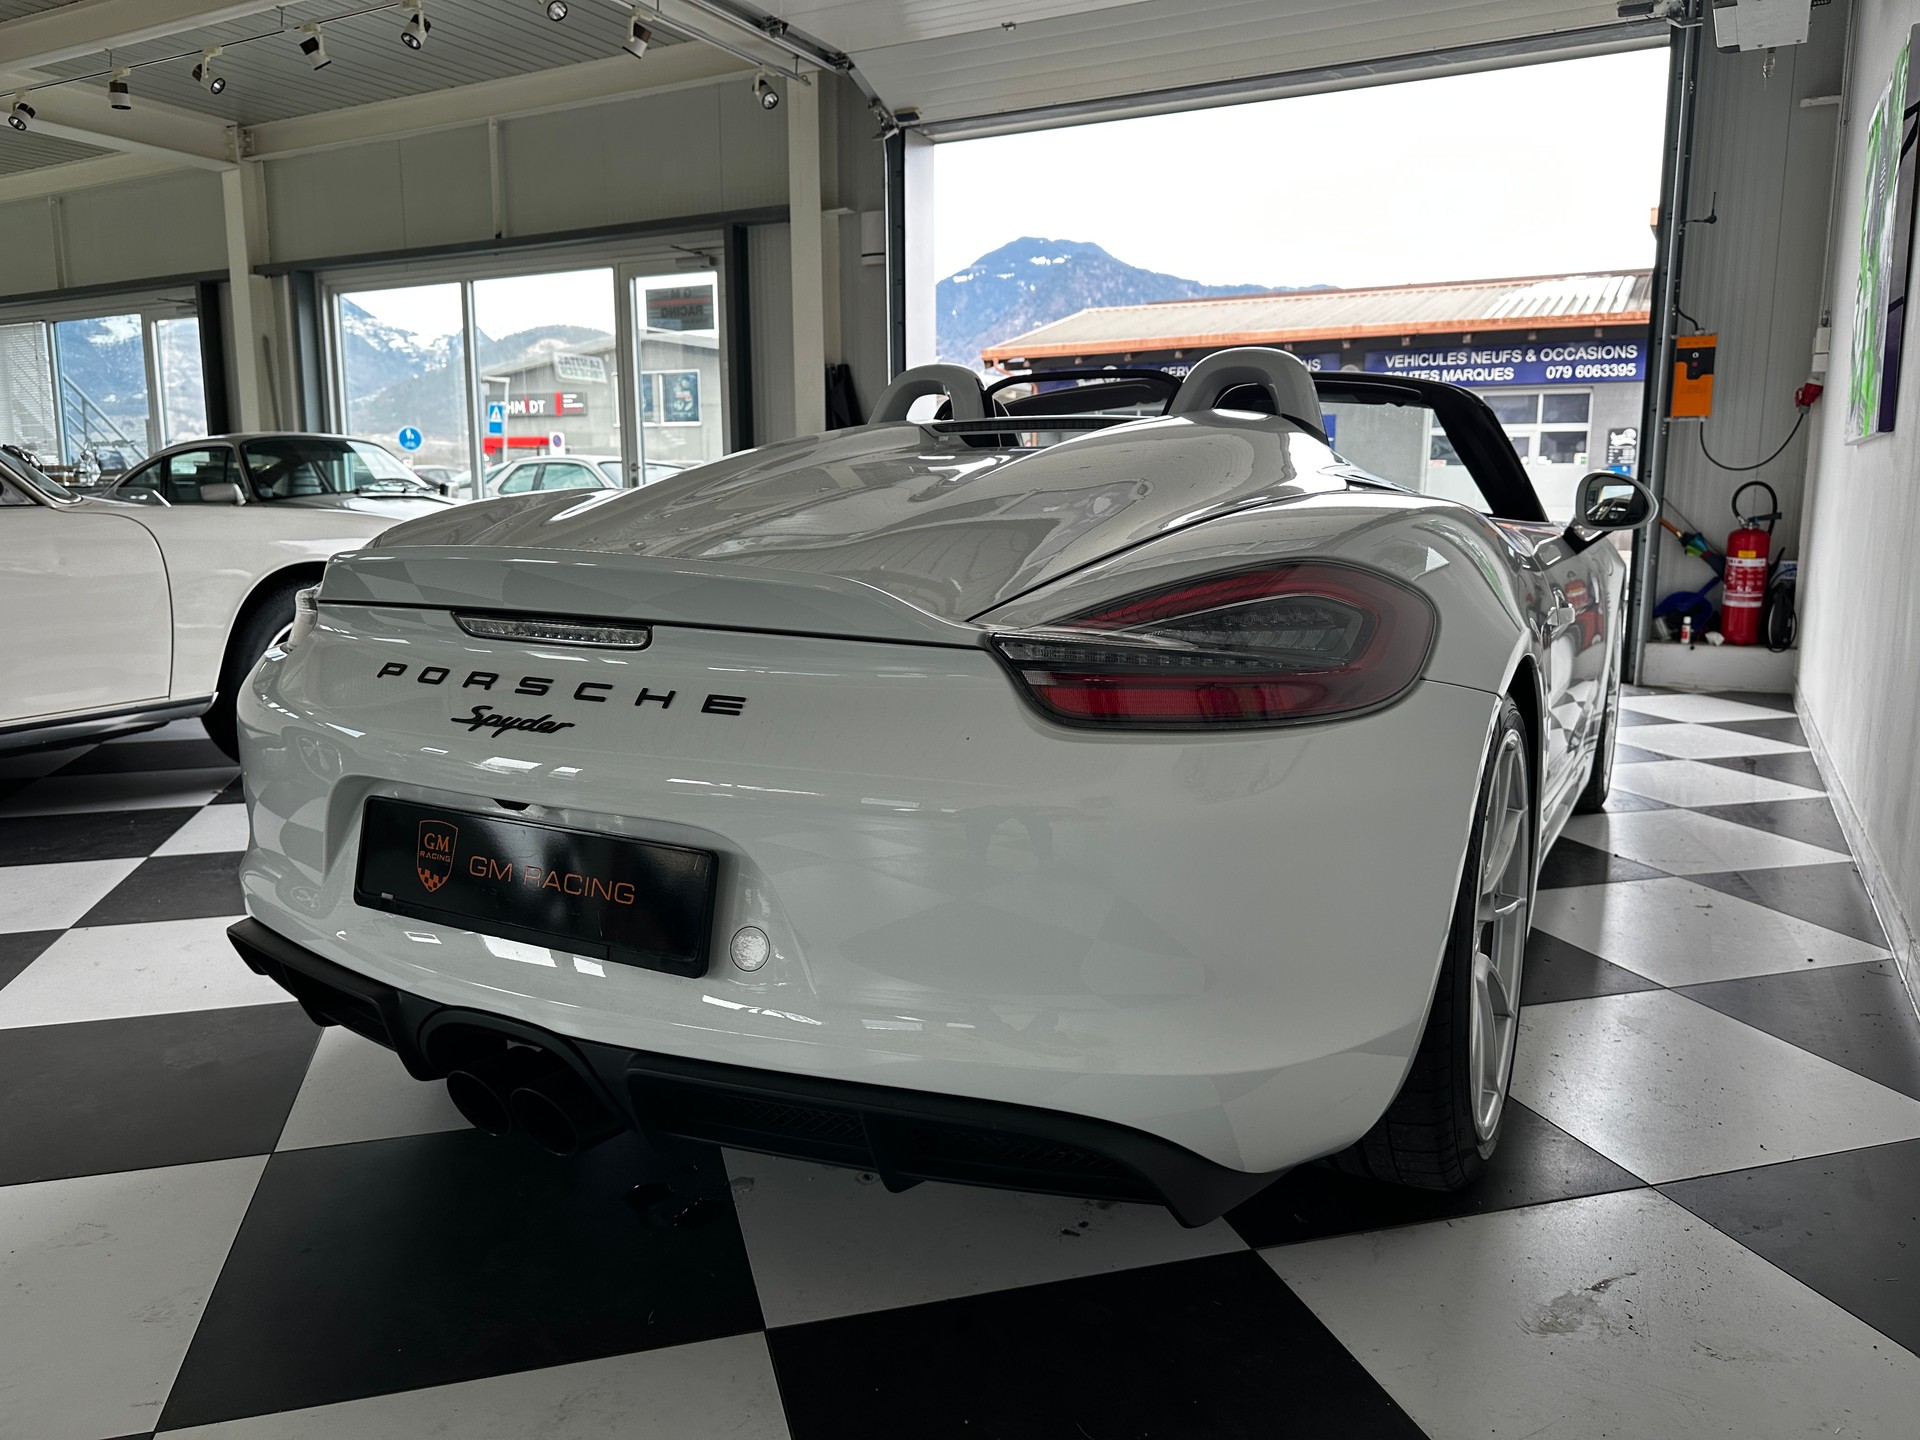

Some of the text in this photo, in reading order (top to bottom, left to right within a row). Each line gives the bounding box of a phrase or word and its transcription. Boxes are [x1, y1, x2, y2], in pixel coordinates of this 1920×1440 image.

[1385, 344, 1638, 368] VEHICULES NEUFS & OCCASIONS
[1441, 367, 1515, 383] MARQUES
[1546, 363, 1637, 379] 079 6063395
[377, 662, 747, 717] PORSCHE
[450, 705, 576, 738] Spyder
[424, 832, 450, 853] GM
[419, 850, 451, 862] RACING
[468, 855, 636, 905] GM RACING
